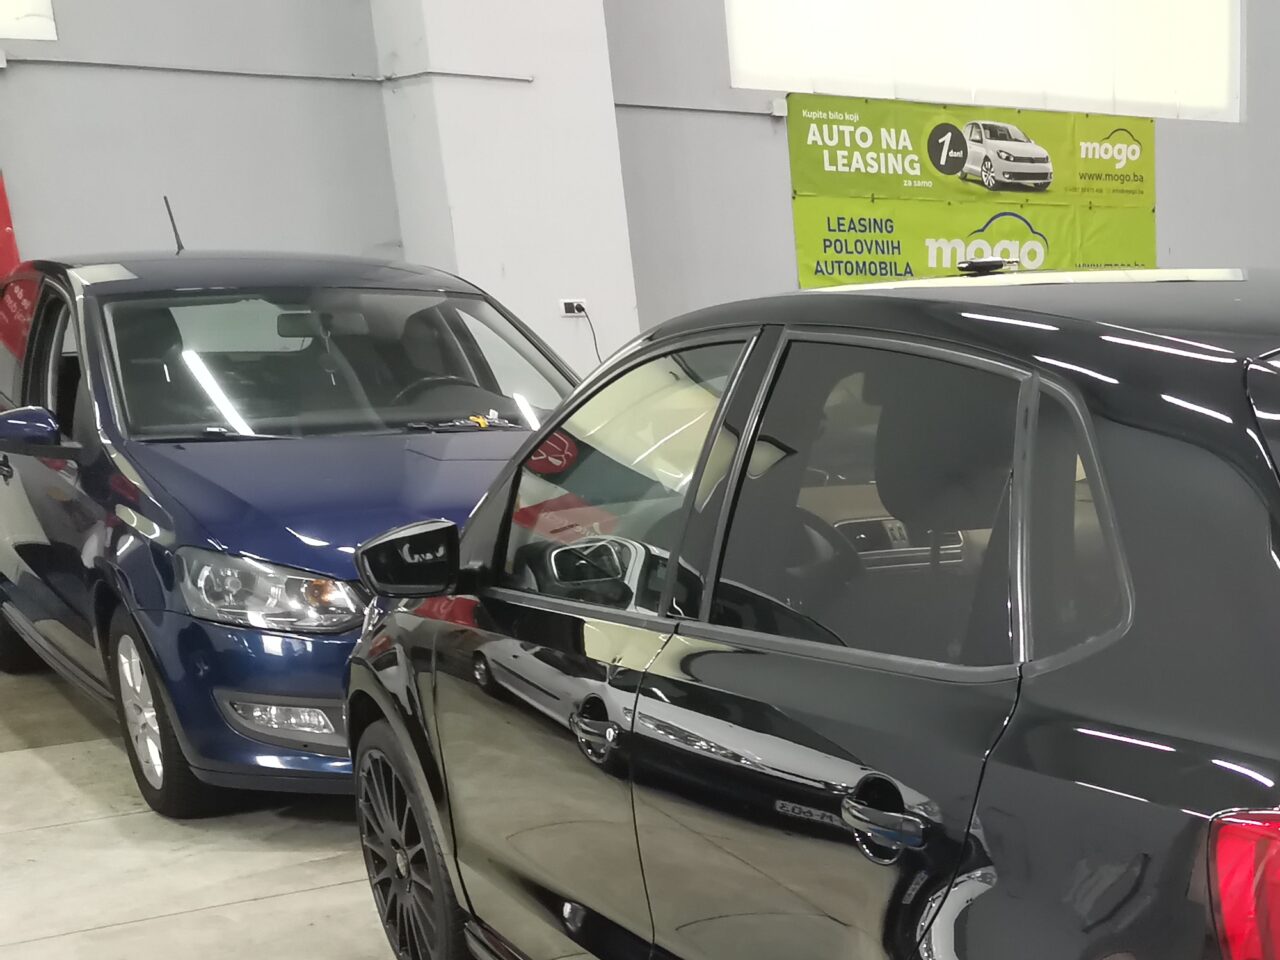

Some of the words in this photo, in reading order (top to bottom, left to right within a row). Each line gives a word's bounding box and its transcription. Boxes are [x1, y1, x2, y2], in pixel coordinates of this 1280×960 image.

[802, 109, 827, 120] Kupite
[828, 111, 843, 119] bilo
[845, 113, 859, 122] koji
[806, 123, 873, 148] AUTO
[880, 128, 913, 150] NA
[938, 131, 952, 166] 1
[1080, 141, 1141, 169] mogo
[823, 149, 921, 176] LEASING
[913, 180, 933, 188] samo
[1079, 172, 1144, 184] www.mogo.ba
[827, 216, 895, 234] LEASING
[823, 238, 902, 255] POLOVNIH
[814, 260, 914, 277] AUTOMOBILA
